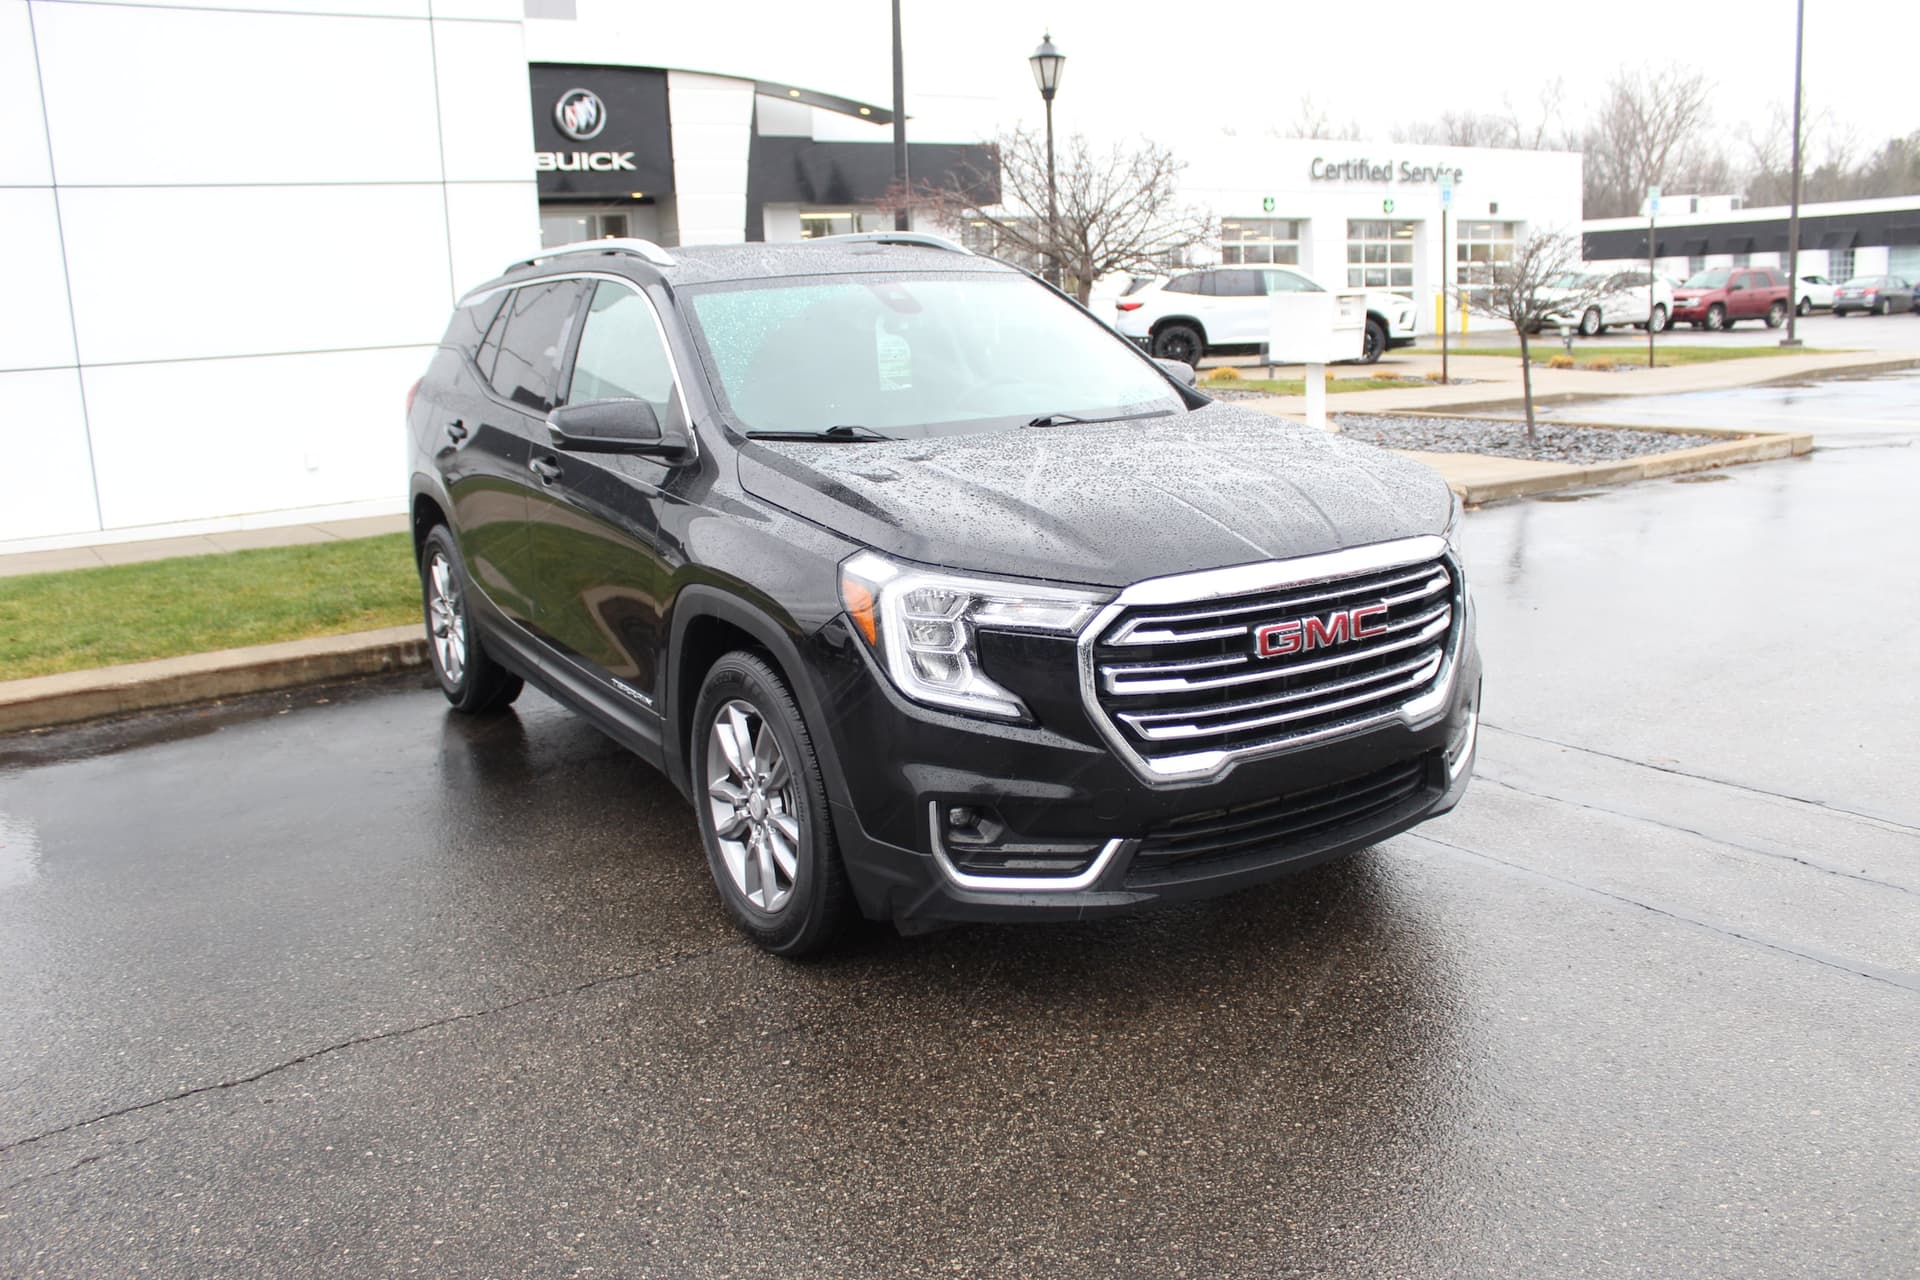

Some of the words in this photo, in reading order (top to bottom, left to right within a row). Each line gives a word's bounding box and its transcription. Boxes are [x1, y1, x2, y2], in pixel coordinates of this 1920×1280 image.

[535, 151, 637, 171] BUICK
[1310, 157, 1393, 182] Certified
[1255, 604, 1388, 658] GMC
